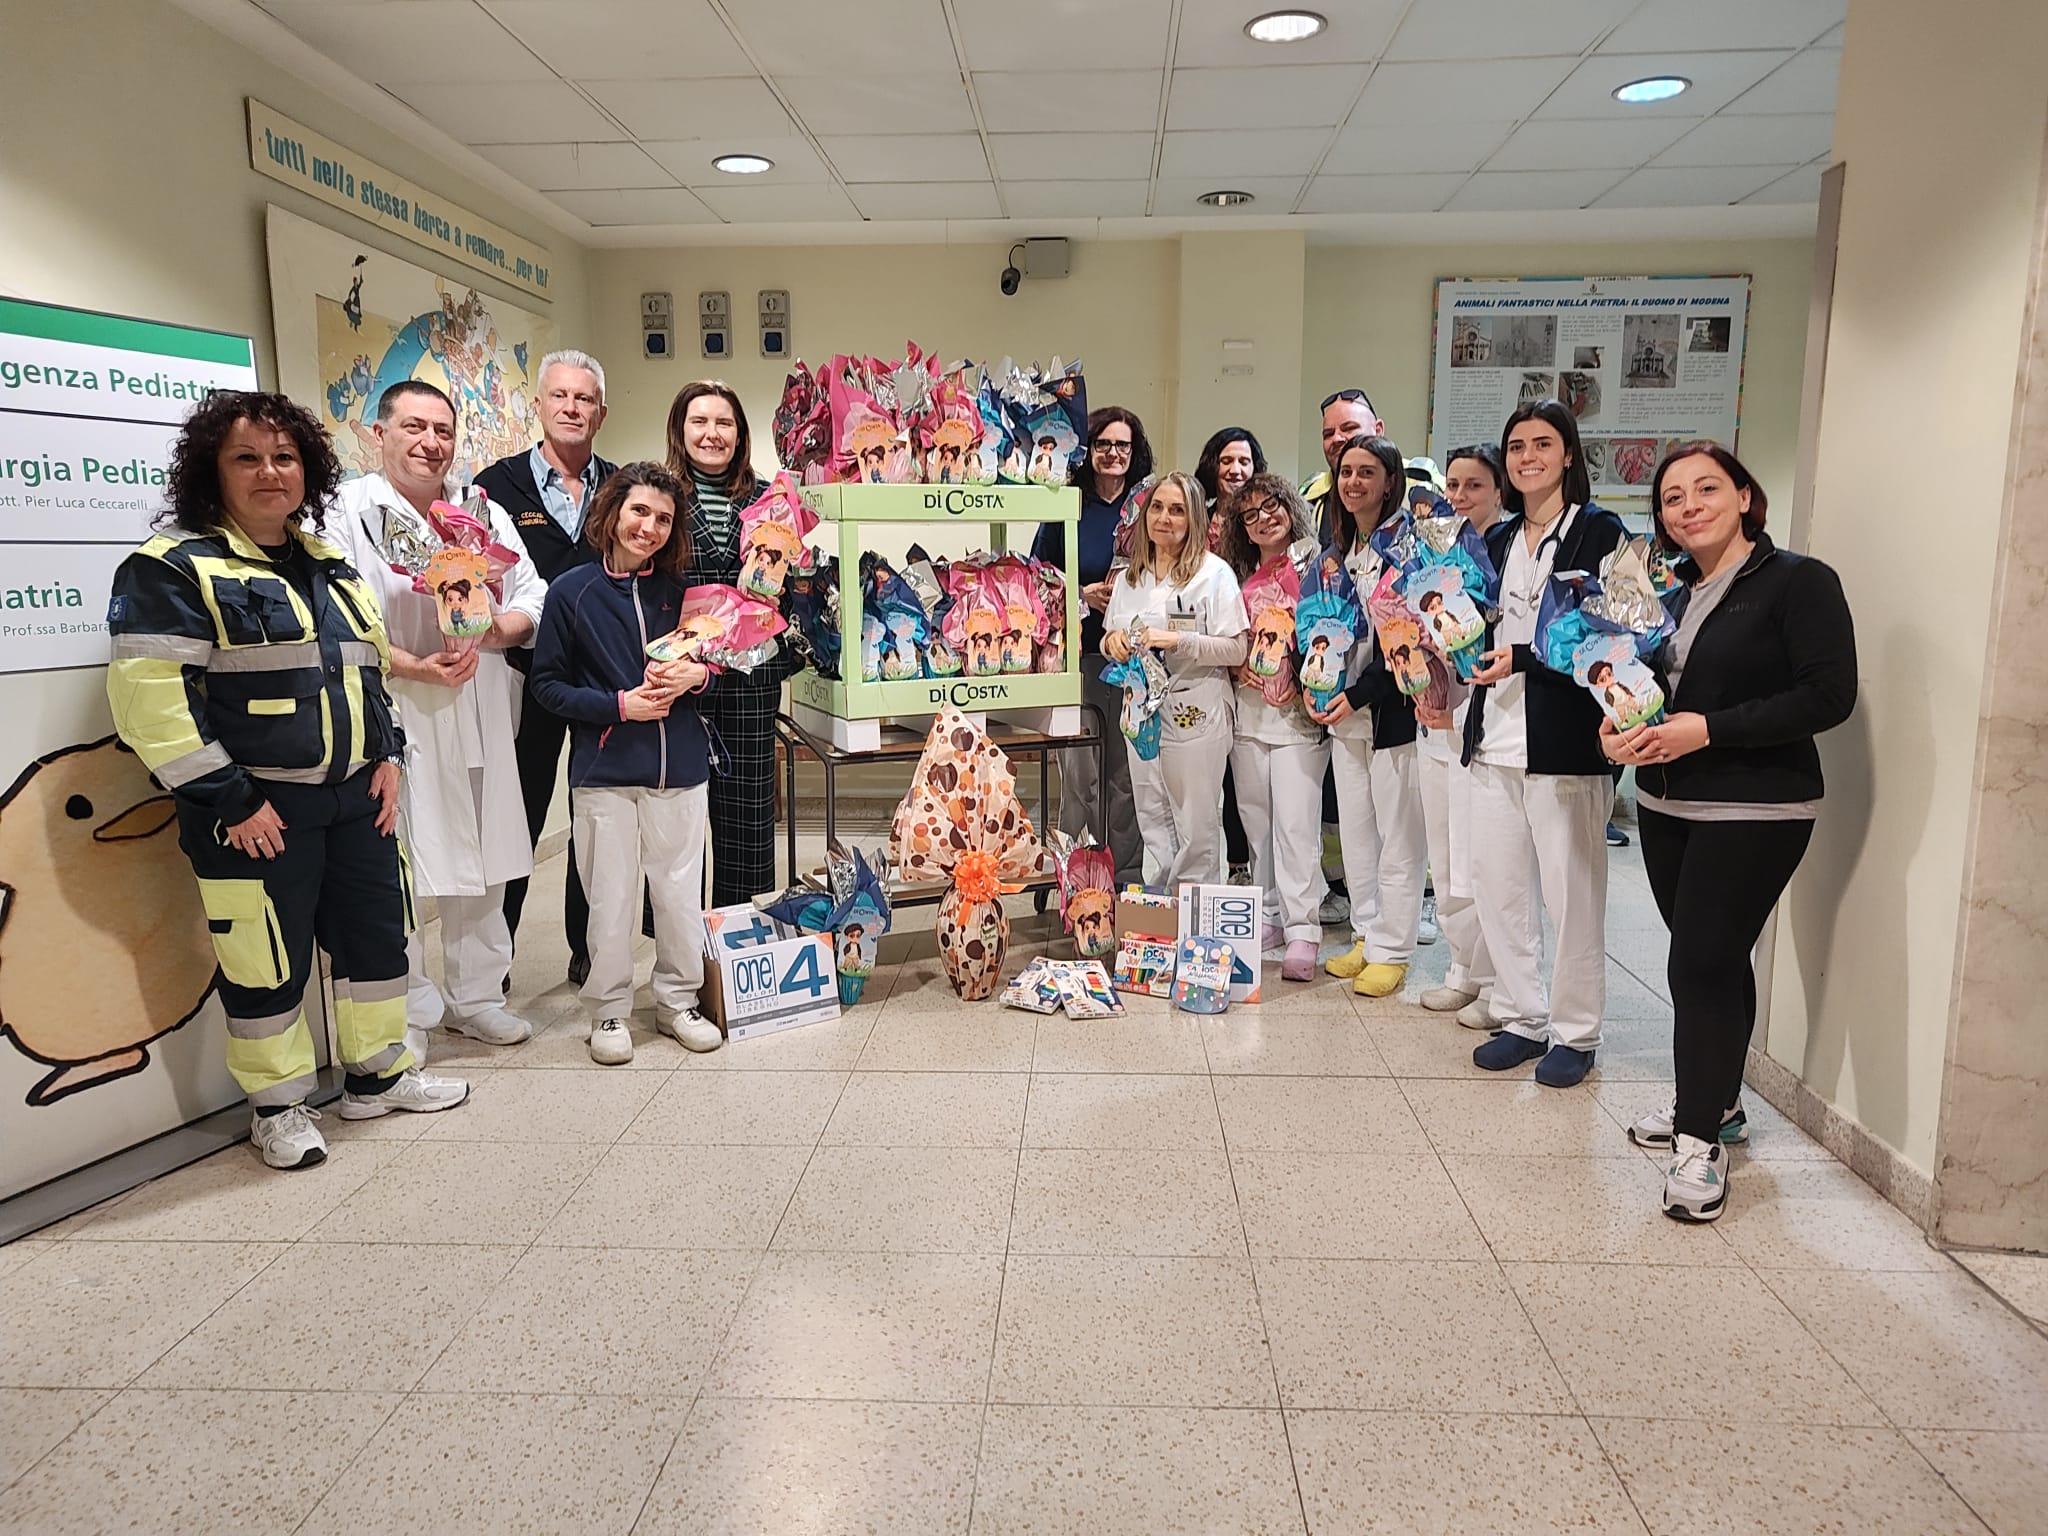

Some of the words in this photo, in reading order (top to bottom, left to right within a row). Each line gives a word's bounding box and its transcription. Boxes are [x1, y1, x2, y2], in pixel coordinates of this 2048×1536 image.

[265, 128, 306, 175] tutti
[313, 156, 355, 198] nella
[361, 181, 408, 223] stessa
[413, 202, 450, 241] barca
[454, 227, 462, 247] a
[1454, 299, 1495, 308] ANIMALI
[1497, 299, 1554, 308] FANTASTICI
[1556, 299, 1588, 307] NELLA
[1641, 298, 1675, 306] DUOMO
[1676, 298, 1687, 306] DI
[1691, 297, 1730, 306] MODENA
[0, 453, 72, 487] rgia
[25, 496, 51, 507] Pier
[56, 497, 85, 508] Luca
[89, 498, 148, 511] Ceccarelli
[946, 490, 1004, 514] COSTA
[951, 683, 1008, 707] COSTA
[1220, 901, 1251, 935] one
[736, 957, 772, 994] one
[779, 944, 829, 997] 4
